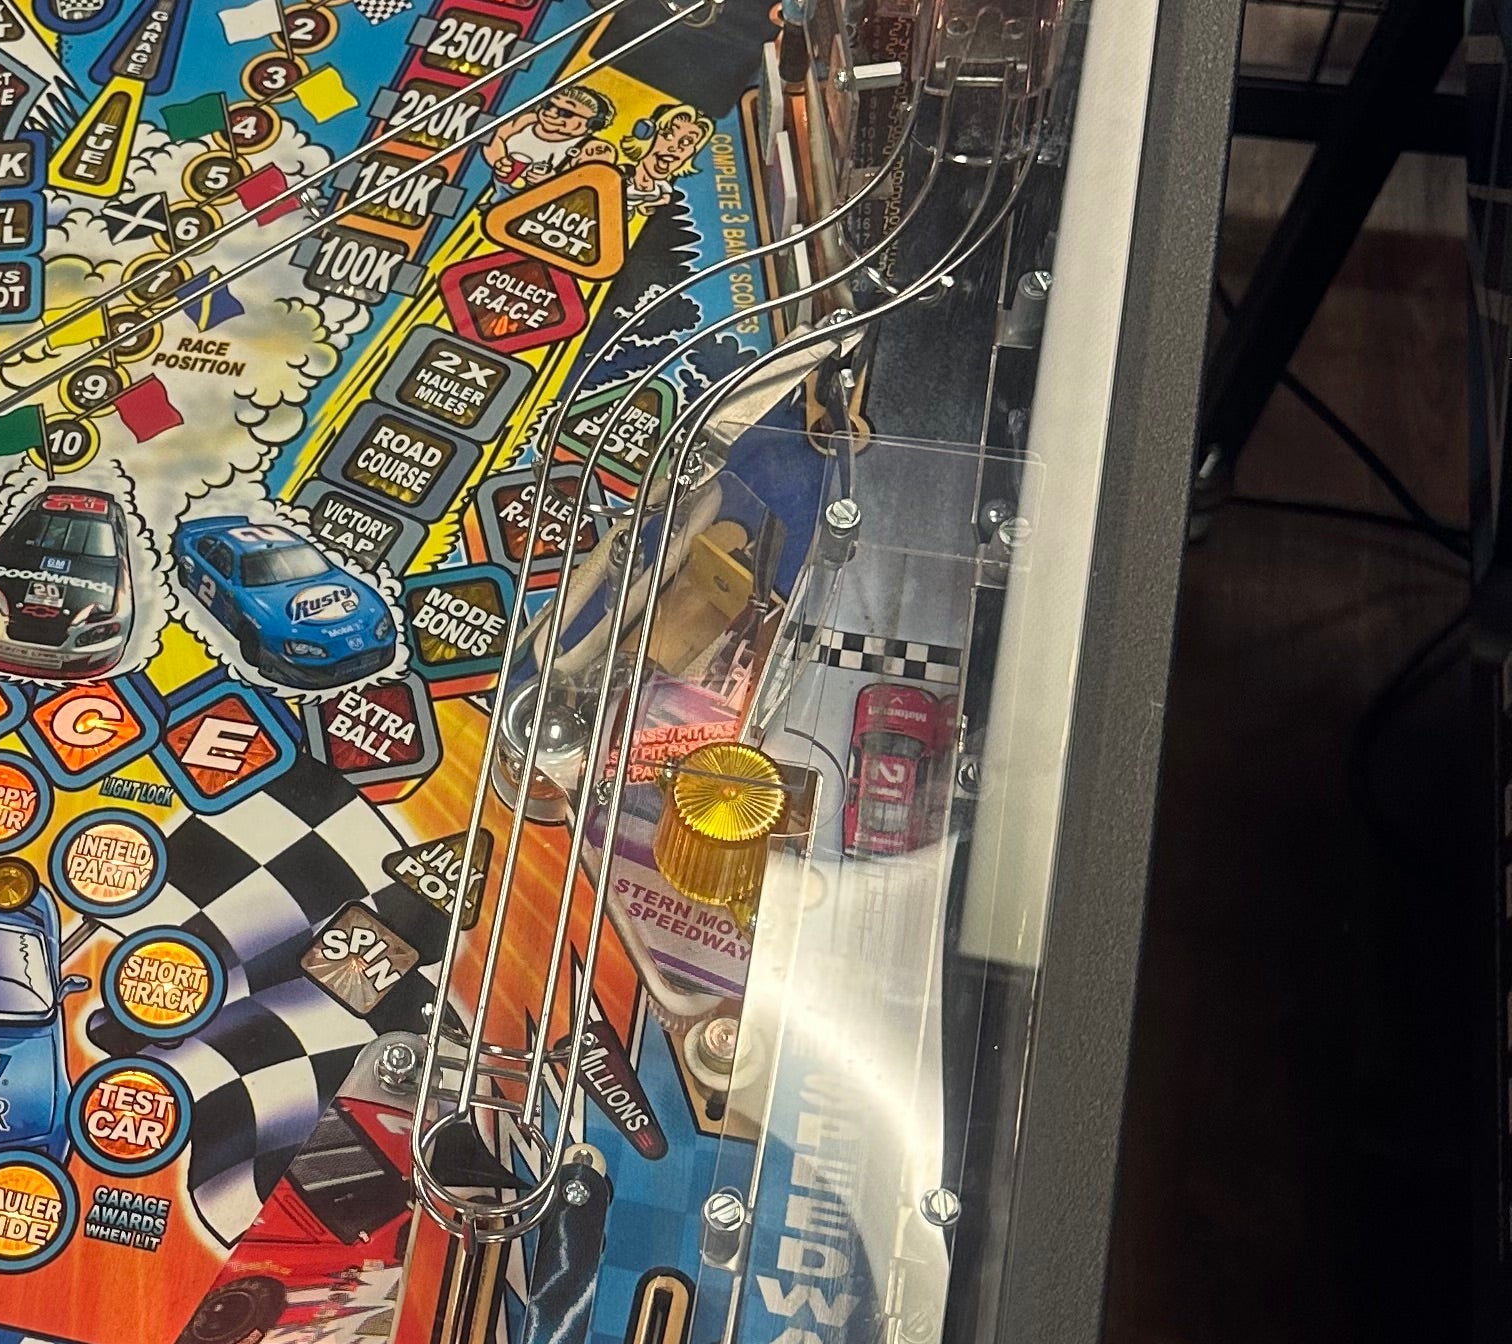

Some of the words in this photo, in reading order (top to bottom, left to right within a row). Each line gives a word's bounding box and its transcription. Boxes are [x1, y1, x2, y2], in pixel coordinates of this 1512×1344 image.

[426, 18, 519, 69] 250K
[515, 219, 593, 257] POT
[534, 203, 599, 239] JACK
[317, 234, 405, 295] 100K
[484, 267, 559, 306] COLLECT
[152, 353, 246, 377] POSITION
[429, 350, 502, 388] 2X
[413, 385, 467, 418] MILES
[414, 368, 487, 408] HAULER
[371, 426, 444, 469] ROAD
[355, 447, 433, 494] COURSE
[320, 499, 395, 541] VICTORY
[423, 586, 507, 635] MODE
[411, 604, 493, 657] BONUS
[51, 695, 125, 747] C
[181, 716, 261, 772] E
[326, 714, 394, 763] BALL
[336, 691, 418, 748] EXTRA
[75, 834, 152, 863] INFIELD
[68, 858, 153, 892] PARTY
[125, 955, 208, 988] SHORT
[321, 926, 403, 993] SPIN
[120, 979, 204, 1014] TRACK
[97, 1082, 176, 1119] TEST
[88, 1110, 165, 1150] CAR
[89, 1203, 167, 1236] AWARDS
[93, 1185, 171, 1217] GARAGE
[84, 1221, 132, 1247] WHEN
